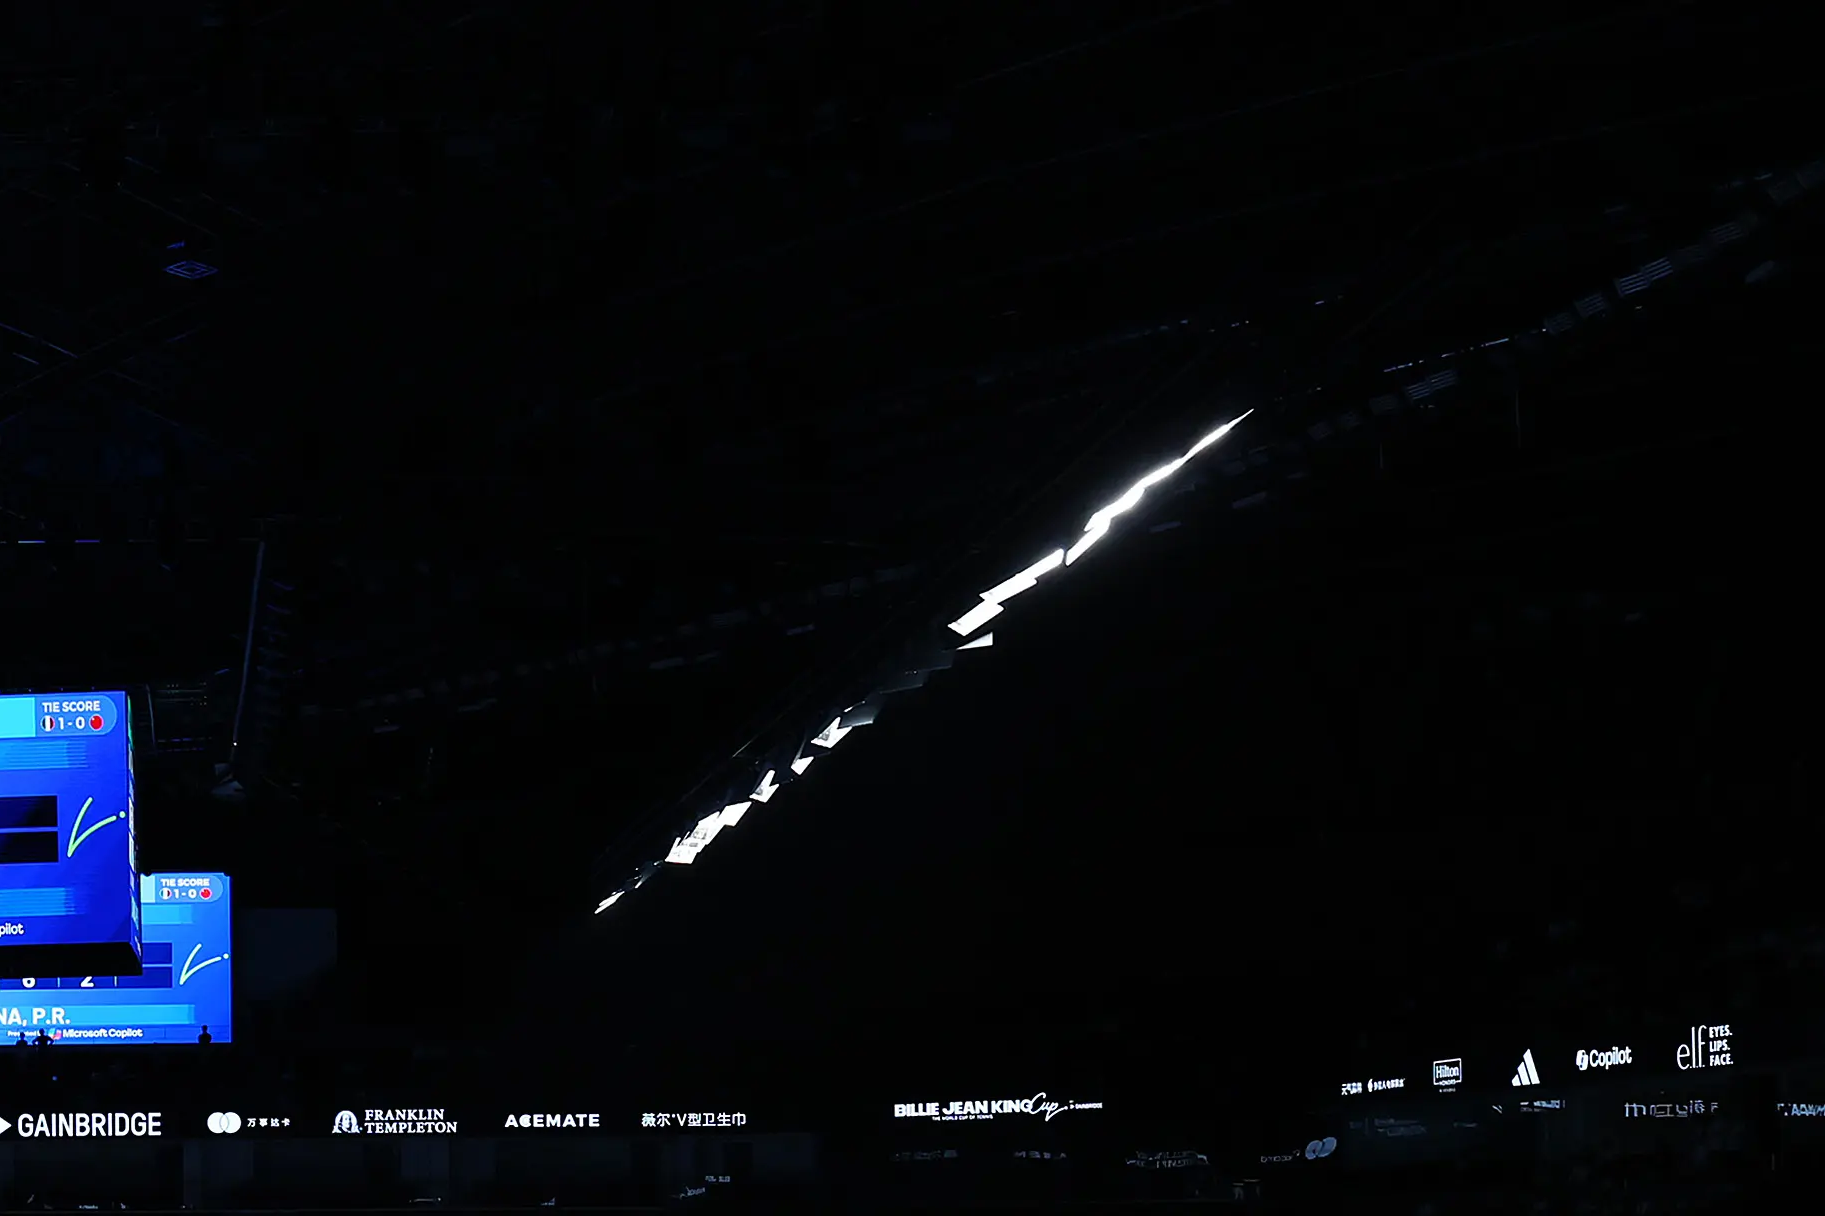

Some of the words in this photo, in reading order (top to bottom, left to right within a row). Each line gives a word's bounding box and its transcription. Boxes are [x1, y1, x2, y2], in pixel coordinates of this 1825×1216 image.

[41, 701, 60, 713] TIE
[62, 700, 101, 712] SCORE
[160, 878, 176, 888] TIE
[177, 877, 210, 887] SCORE
[32, 1007, 70, 1025] P.R.
[62, 1028, 108, 1038] Microsoft
[108, 1028, 143, 1039] Copilot
[1708, 1024, 1733, 1039] EYES.
[1709, 1039, 1731, 1053] LIPS.
[1589, 1045, 1633, 1070] Copilot
[1709, 1052, 1734, 1067] FACE.
[1435, 1065, 1460, 1079] Hilton
[893, 1103, 940, 1117] BILLIE
[942, 1101, 989, 1115] JEAN
[991, 1099, 1032, 1114] KING
[1029, 1092, 1068, 1122] Cup
[364, 1108, 445, 1121] FRANKLIN
[504, 1113, 601, 1128] ACEMATE
[17, 1112, 162, 1137] GAINBRIDGE
[364, 1121, 458, 1134] TEMPLETON
